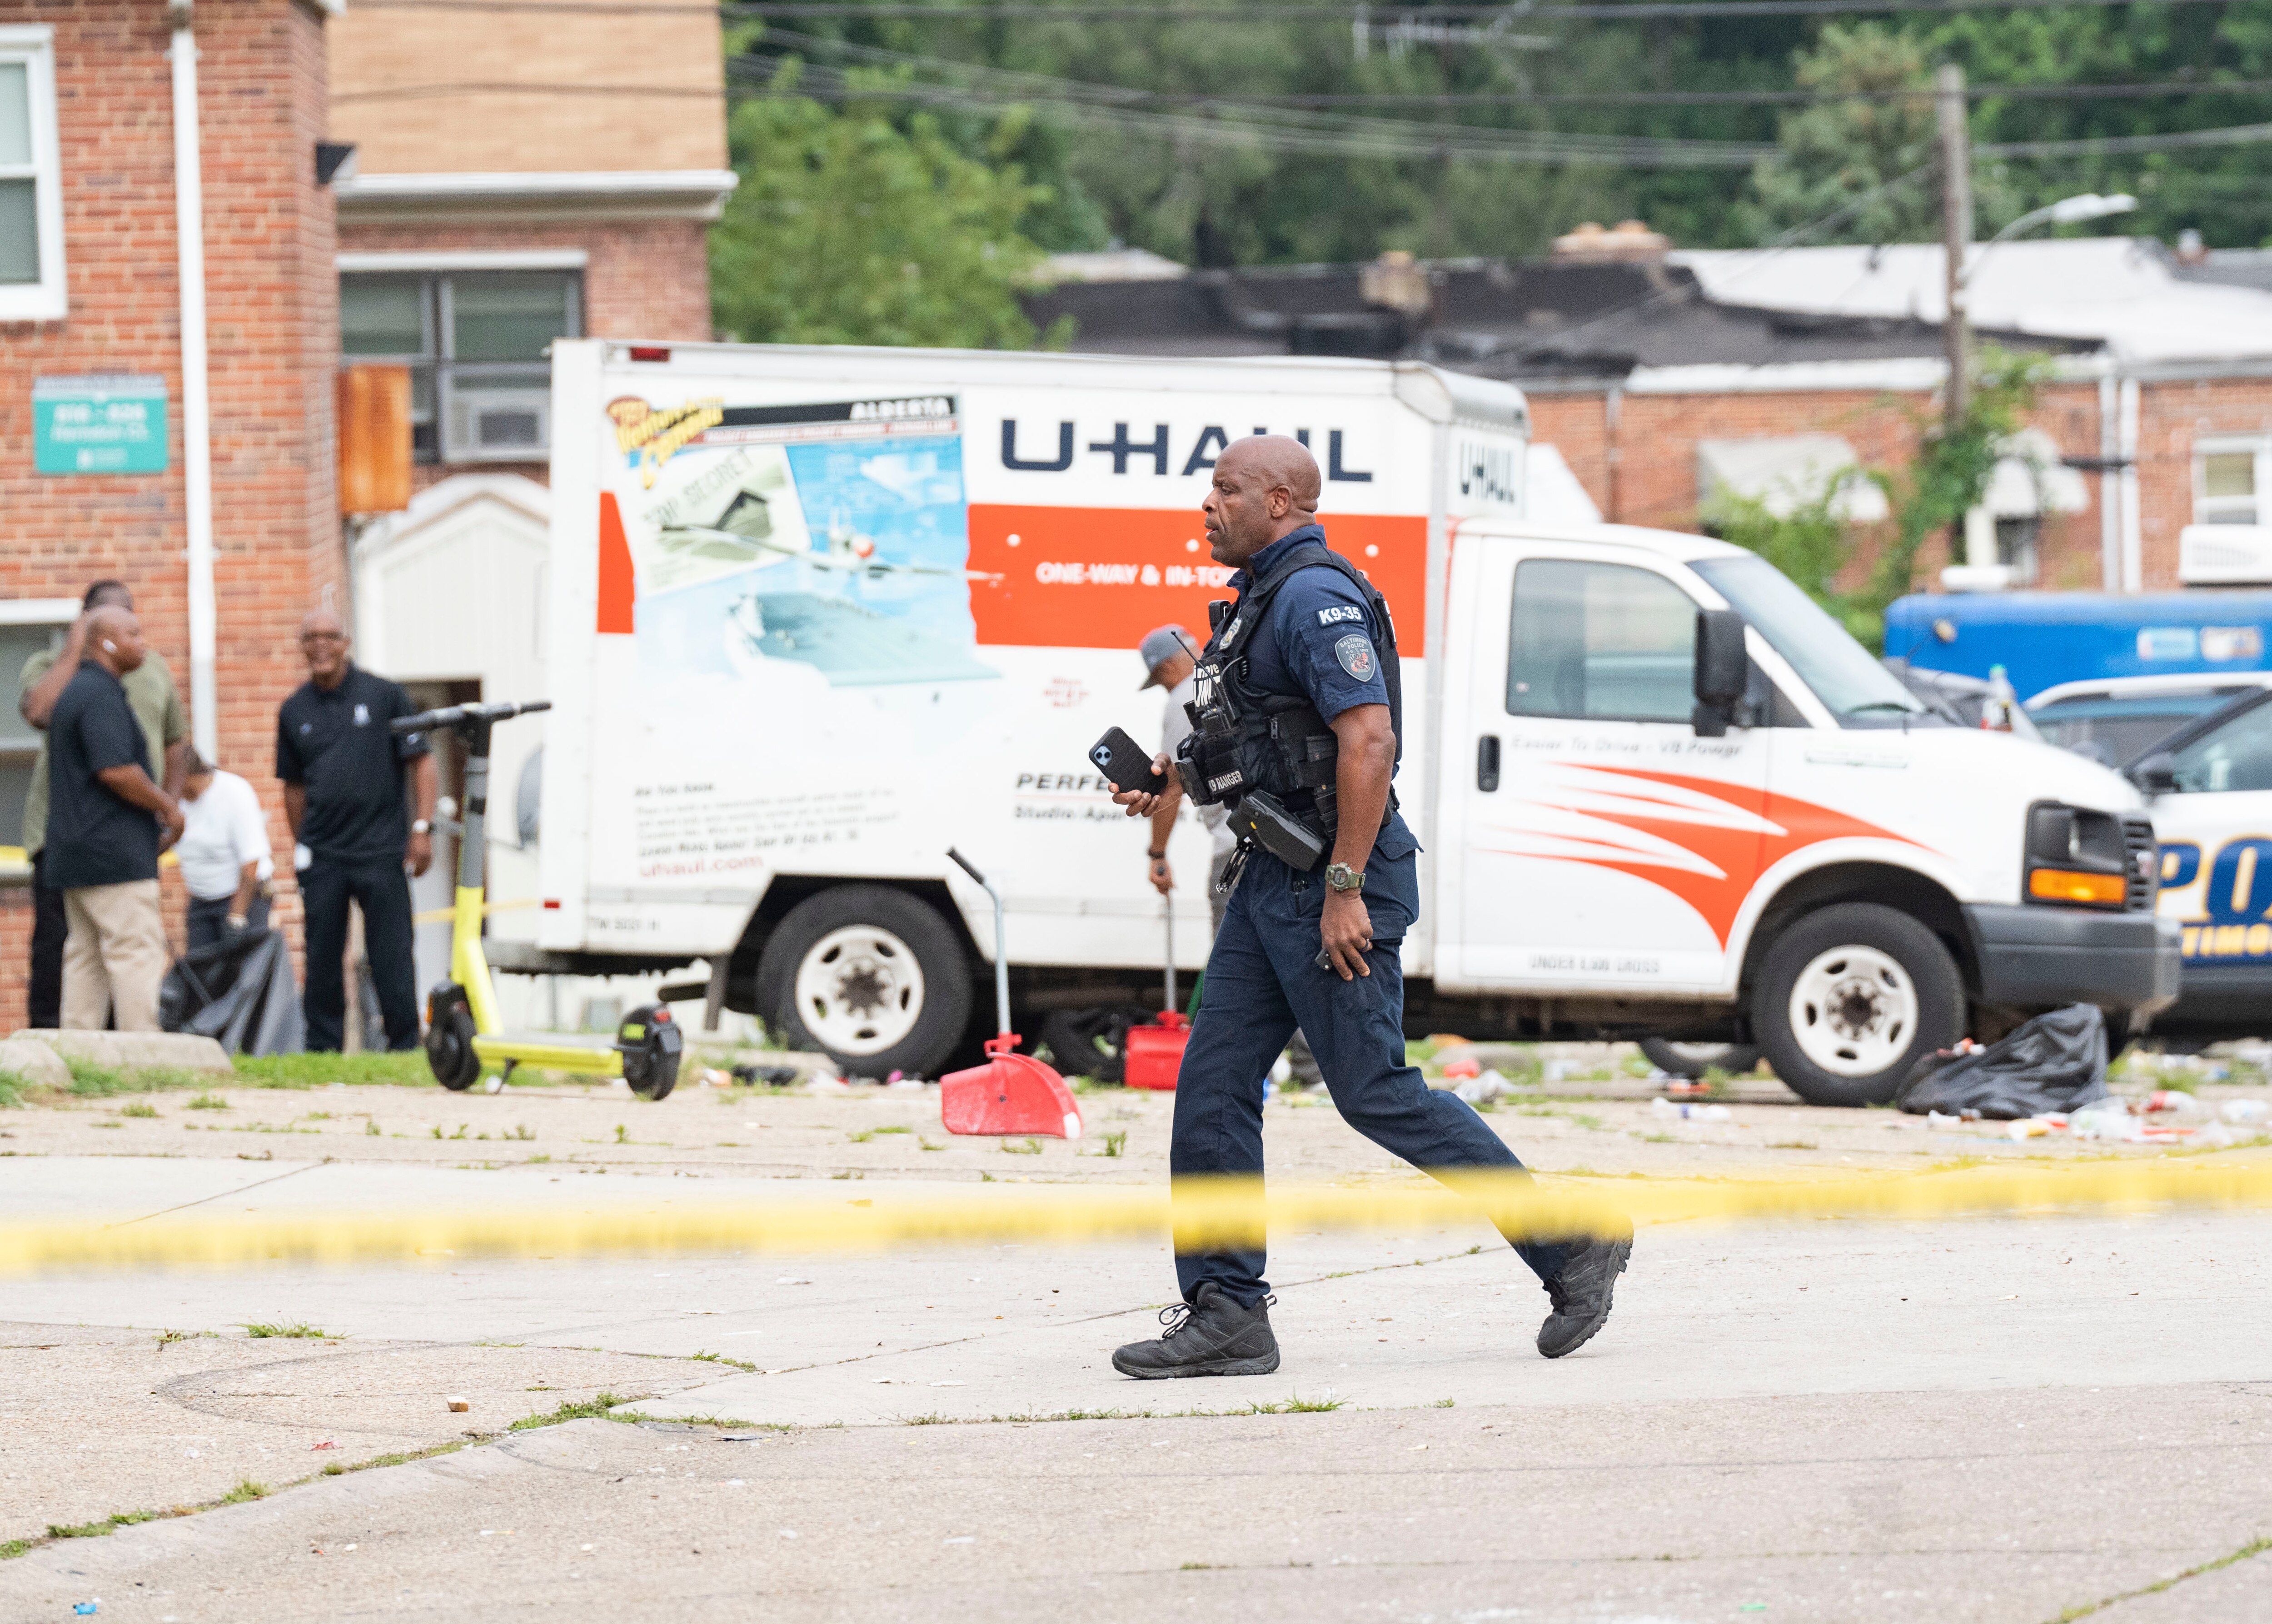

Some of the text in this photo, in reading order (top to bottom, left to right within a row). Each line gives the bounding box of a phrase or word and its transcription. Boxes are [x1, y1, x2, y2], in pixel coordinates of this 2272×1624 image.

[849, 397, 951, 420] ALBERTA
[1001, 419, 1372, 482] U-HAL
[1036, 562, 1138, 585] ONE-WAY
[1141, 564, 1161, 587] &
[1319, 606, 1361, 624] K9-35
[1340, 638, 1367, 648] BALTIMORE
[1216, 771, 1243, 789] RANGER
[640, 857, 763, 877] uhaul.com
[2182, 925, 2272, 957] TIMO
